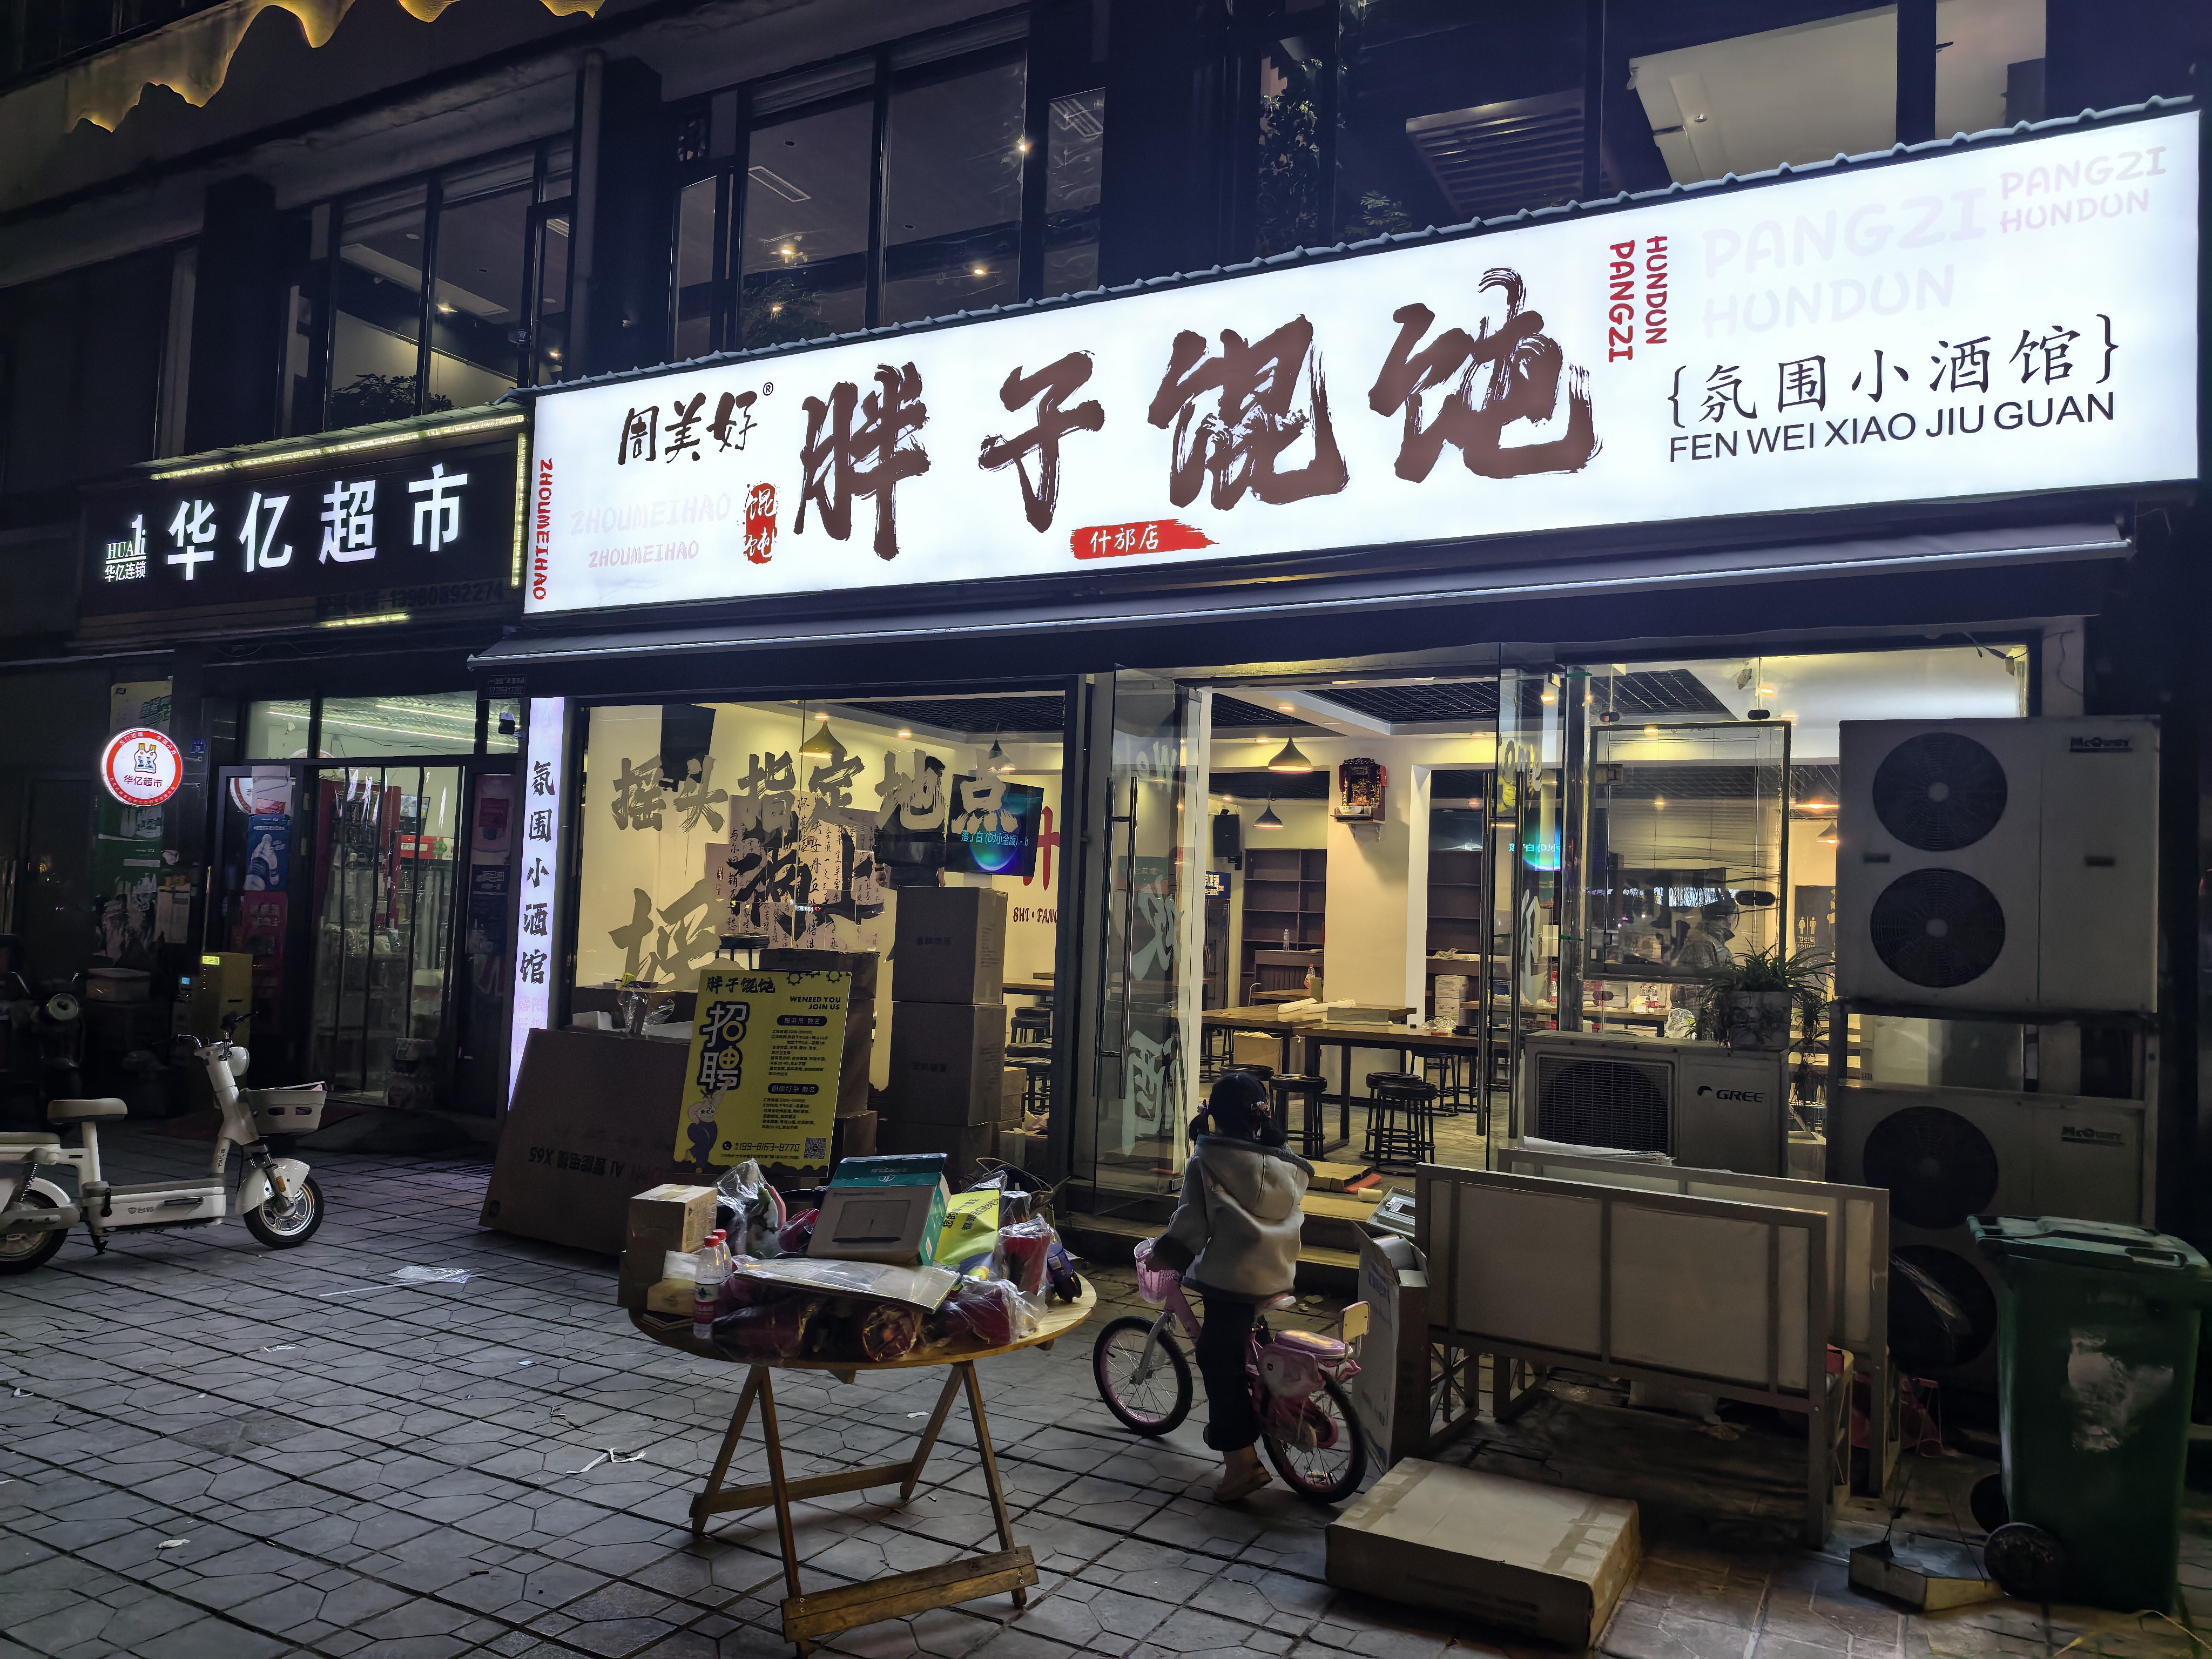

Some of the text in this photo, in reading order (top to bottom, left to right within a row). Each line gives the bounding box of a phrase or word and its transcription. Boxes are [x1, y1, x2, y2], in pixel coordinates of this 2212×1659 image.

[2001, 188, 2150, 234] HUNDUN
[1608, 240, 1635, 363] PANGZI
[1645, 235, 1668, 345] HUNDUN
[1702, 264, 1955, 339] HUNDUN
[618, 390, 758, 466] 周美好
[794, 267, 1603, 561] 胖子馄饨
[1670, 392, 2115, 463] FEN WEI XIAO JIU GUAN
[167, 463, 468, 582] 华亿超市
[533, 458, 554, 601] ZHOUMEIHAO
[570, 493, 732, 537] ZHOUMEIHAO
[1089, 525, 1161, 554] 什邡店
[105, 561, 146, 582] 华亿连锁
[589, 540, 699, 569] ZHOUMEIHAO
[124, 775, 163, 787] 华亿超市
[519, 760, 555, 984] 氛围小酒馆
[706, 975, 776, 994] 胖子馄饨
[698, 1003, 748, 1090] 招聘
[1717, 1089, 1765, 1103] GREE
